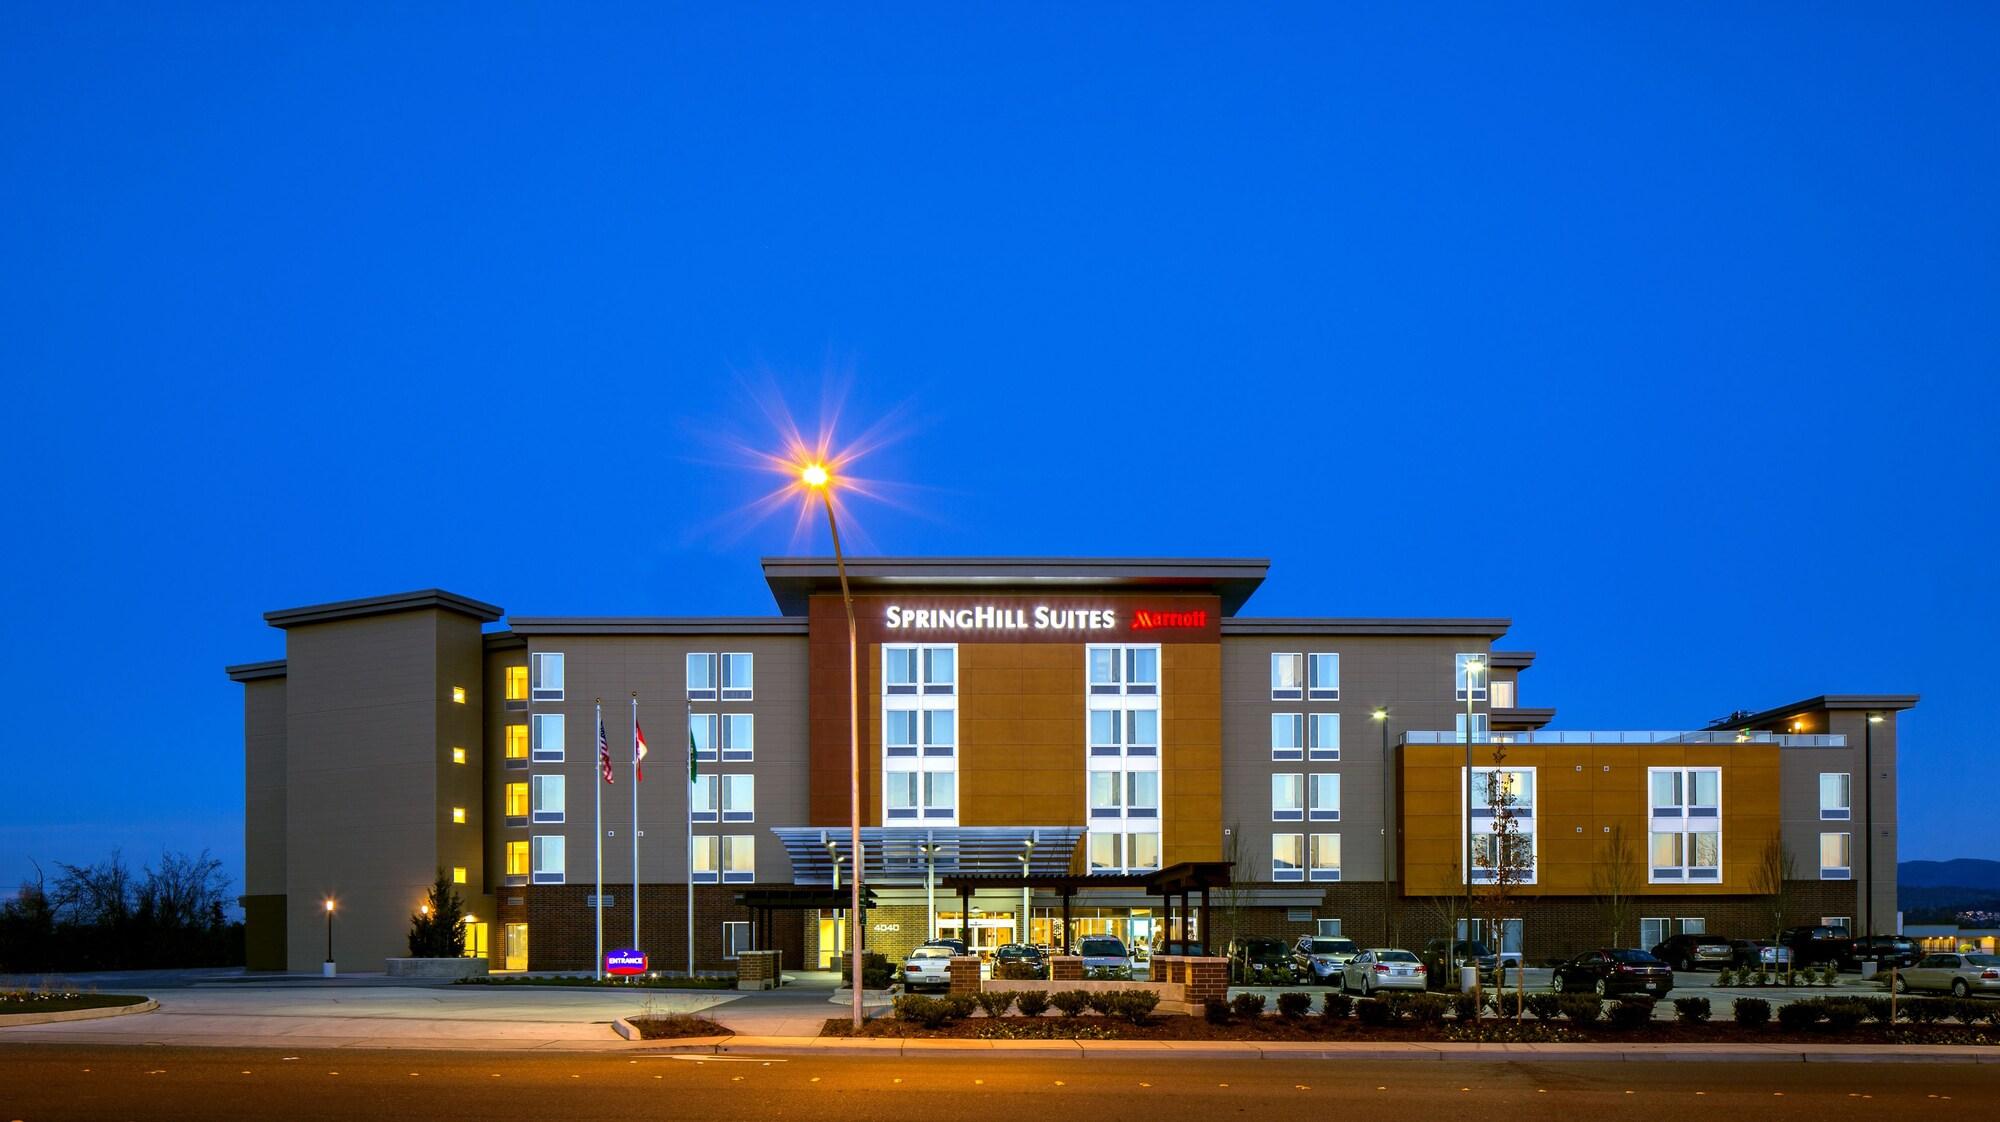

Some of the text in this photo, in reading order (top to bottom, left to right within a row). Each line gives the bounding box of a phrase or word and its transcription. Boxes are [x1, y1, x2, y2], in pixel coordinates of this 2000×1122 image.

[885, 605, 1116, 629] SPRINGHILL SUITES
[1132, 610, 1206, 630] Marriott
[874, 924, 900, 932] 4040
